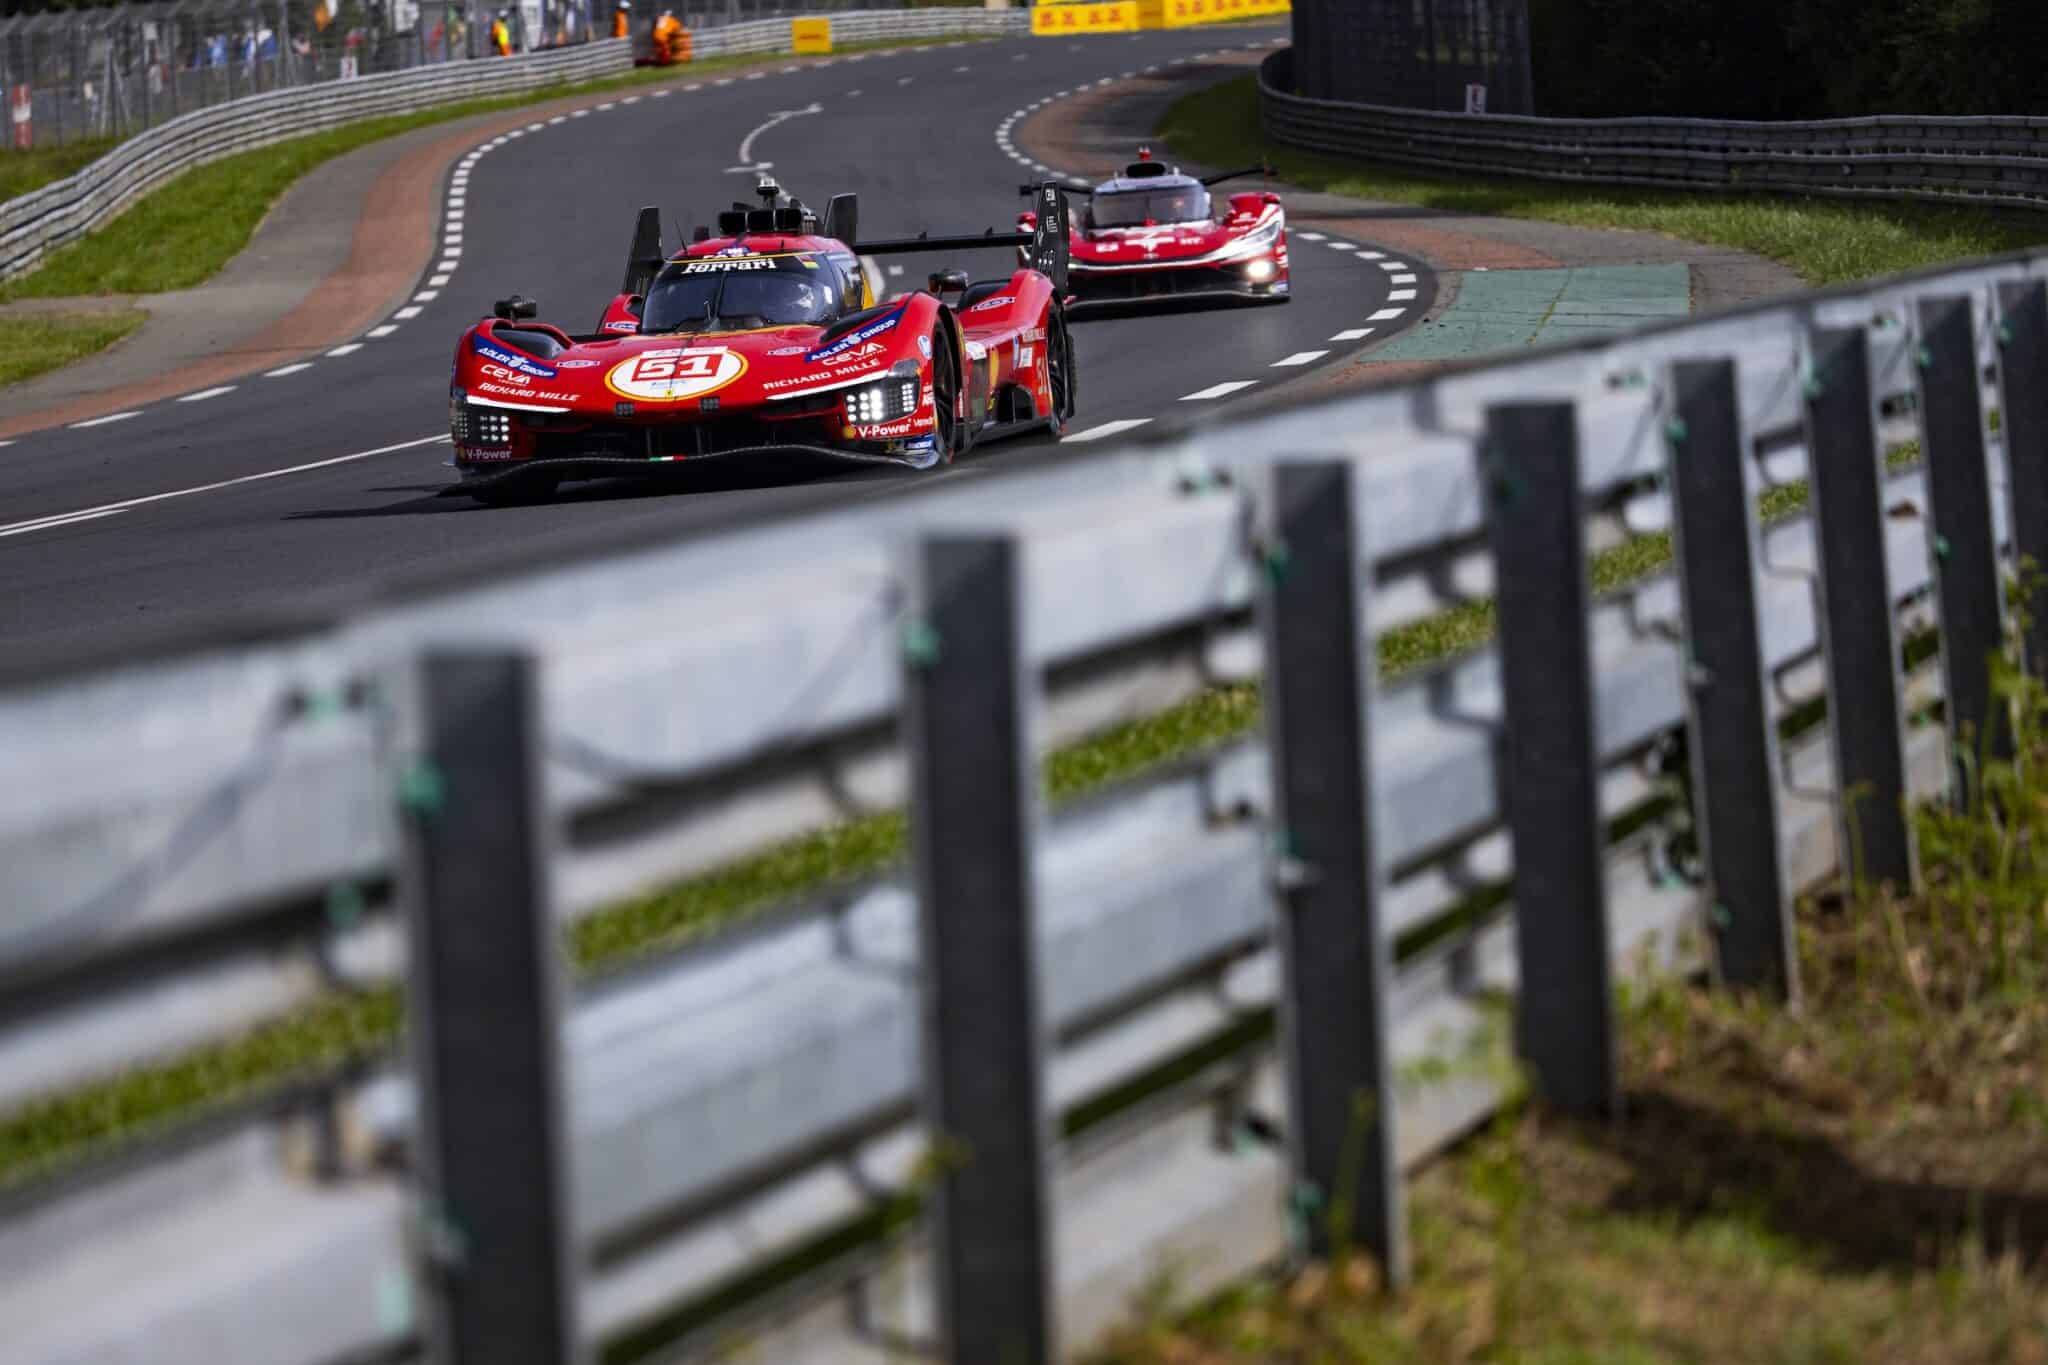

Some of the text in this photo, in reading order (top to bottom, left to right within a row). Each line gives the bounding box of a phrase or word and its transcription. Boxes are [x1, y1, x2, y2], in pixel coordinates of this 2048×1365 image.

[681, 259, 777, 274] Ferrari
[811, 342, 850, 360] ADLER
[861, 319, 896, 338] GROUP
[637, 354, 713, 379] 51
[762, 358, 880, 390] RICHARD MILLE
[479, 382, 536, 397] RICHARD
[536, 391, 581, 402] MILLE
[858, 423, 911, 438] V-Power
[466, 448, 512, 459] V-Power
